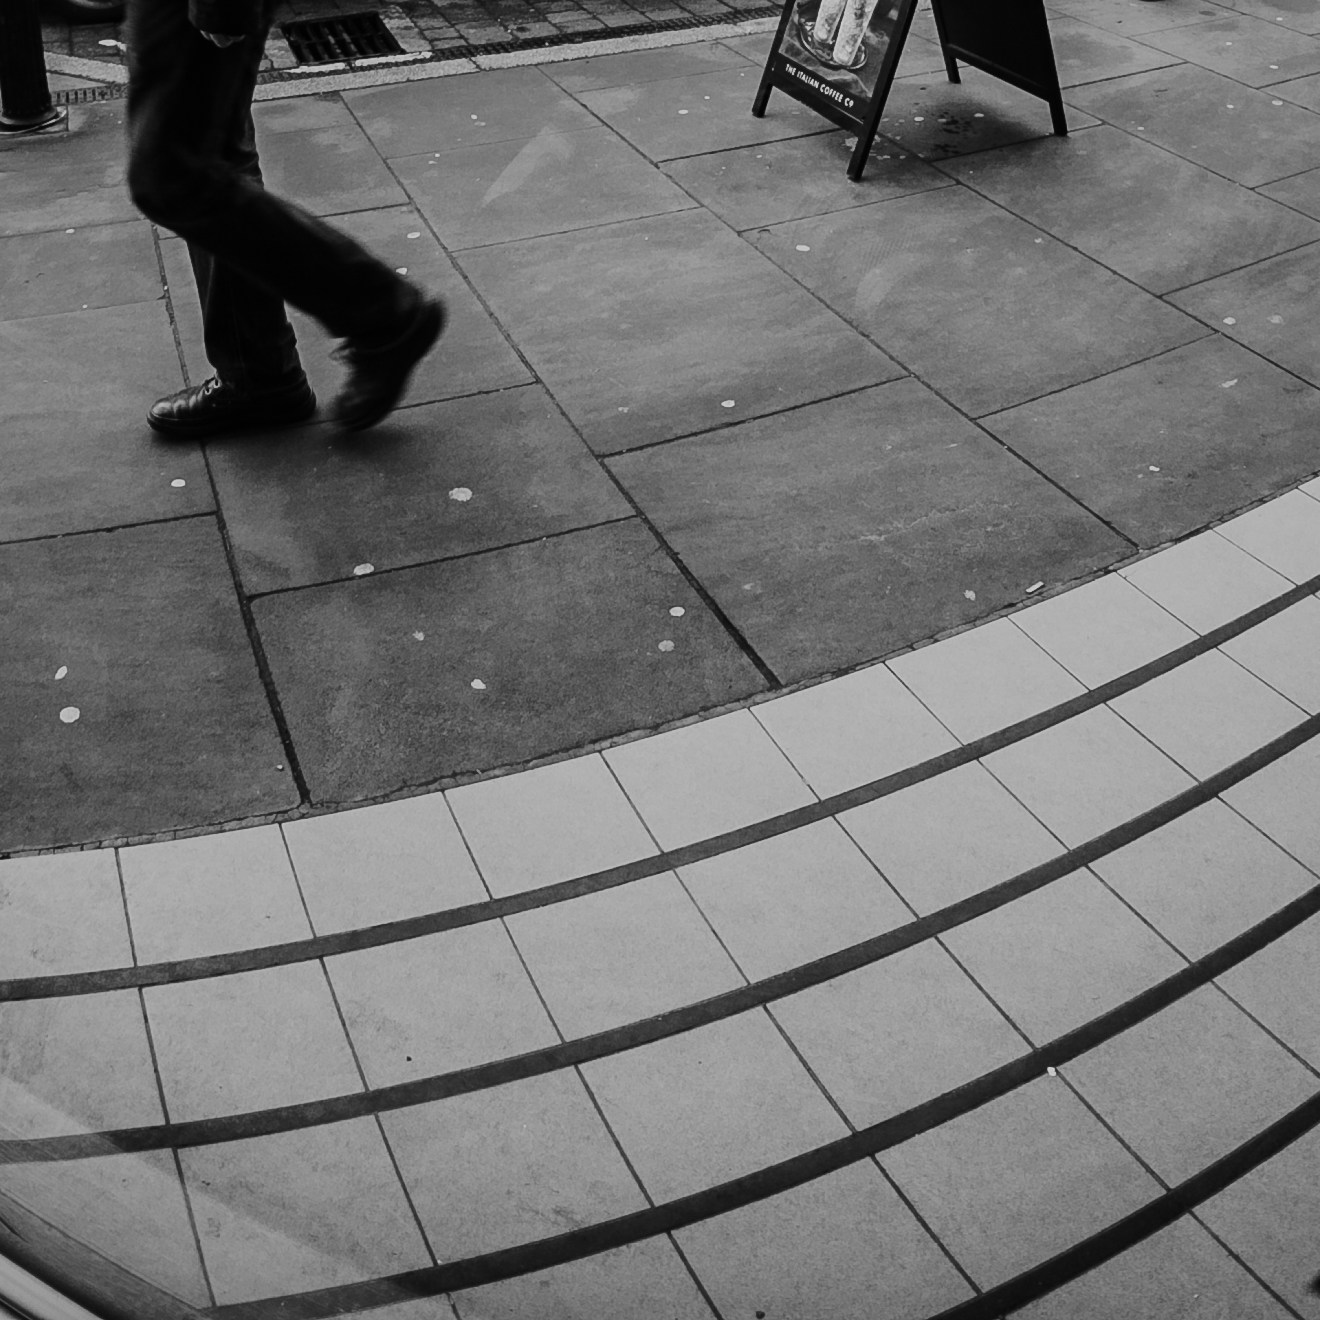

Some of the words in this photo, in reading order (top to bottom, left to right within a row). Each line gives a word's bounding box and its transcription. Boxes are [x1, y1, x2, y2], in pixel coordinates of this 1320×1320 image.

[785, 63, 797, 76] THE
[796, 70, 820, 89] ITALIAN
[820, 83, 844, 103] COFFEE
